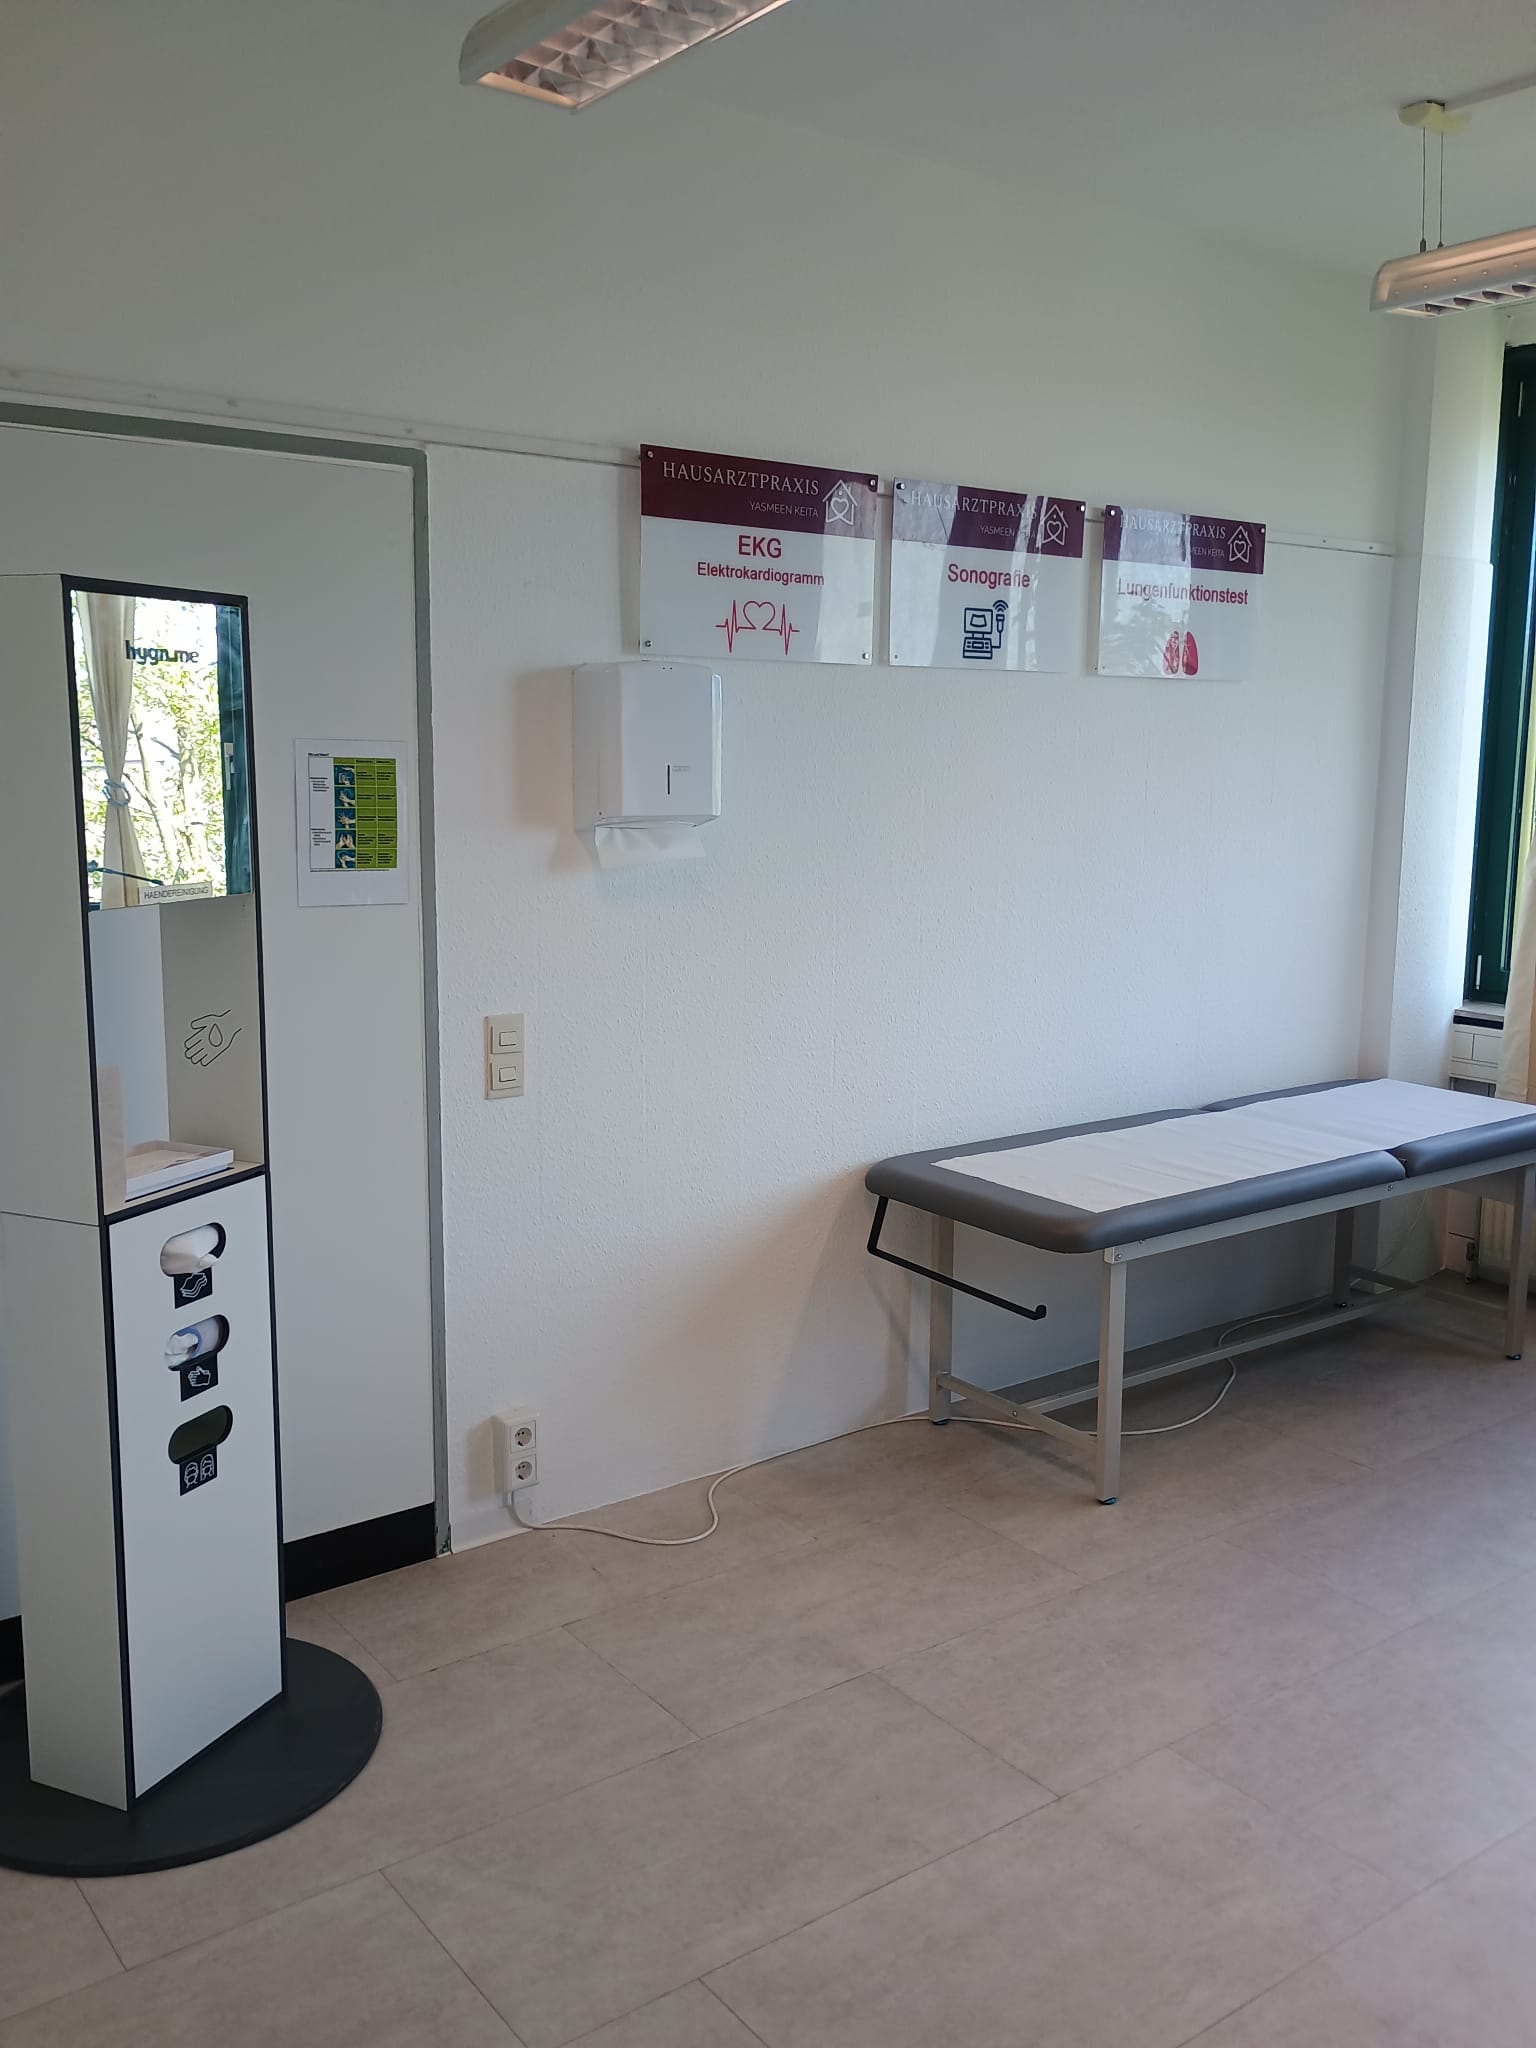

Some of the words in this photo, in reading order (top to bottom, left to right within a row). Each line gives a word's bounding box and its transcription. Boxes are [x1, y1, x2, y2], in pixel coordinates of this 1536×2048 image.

[663, 461, 819, 495] HAUSARZTPRAXIS
[750, 501, 793, 515] YASMEEN
[794, 506, 818, 518] KEITA
[911, 490, 1037, 519] HAUSARZTPRAXIS
[980, 526, 1015, 537] YASMEEN
[738, 534, 782, 559] EKG
[697, 561, 825, 586] Elektrokardiogramm
[947, 563, 1030, 589] Sonografie
[1118, 577, 1249, 605] Lungenfunktionstest
